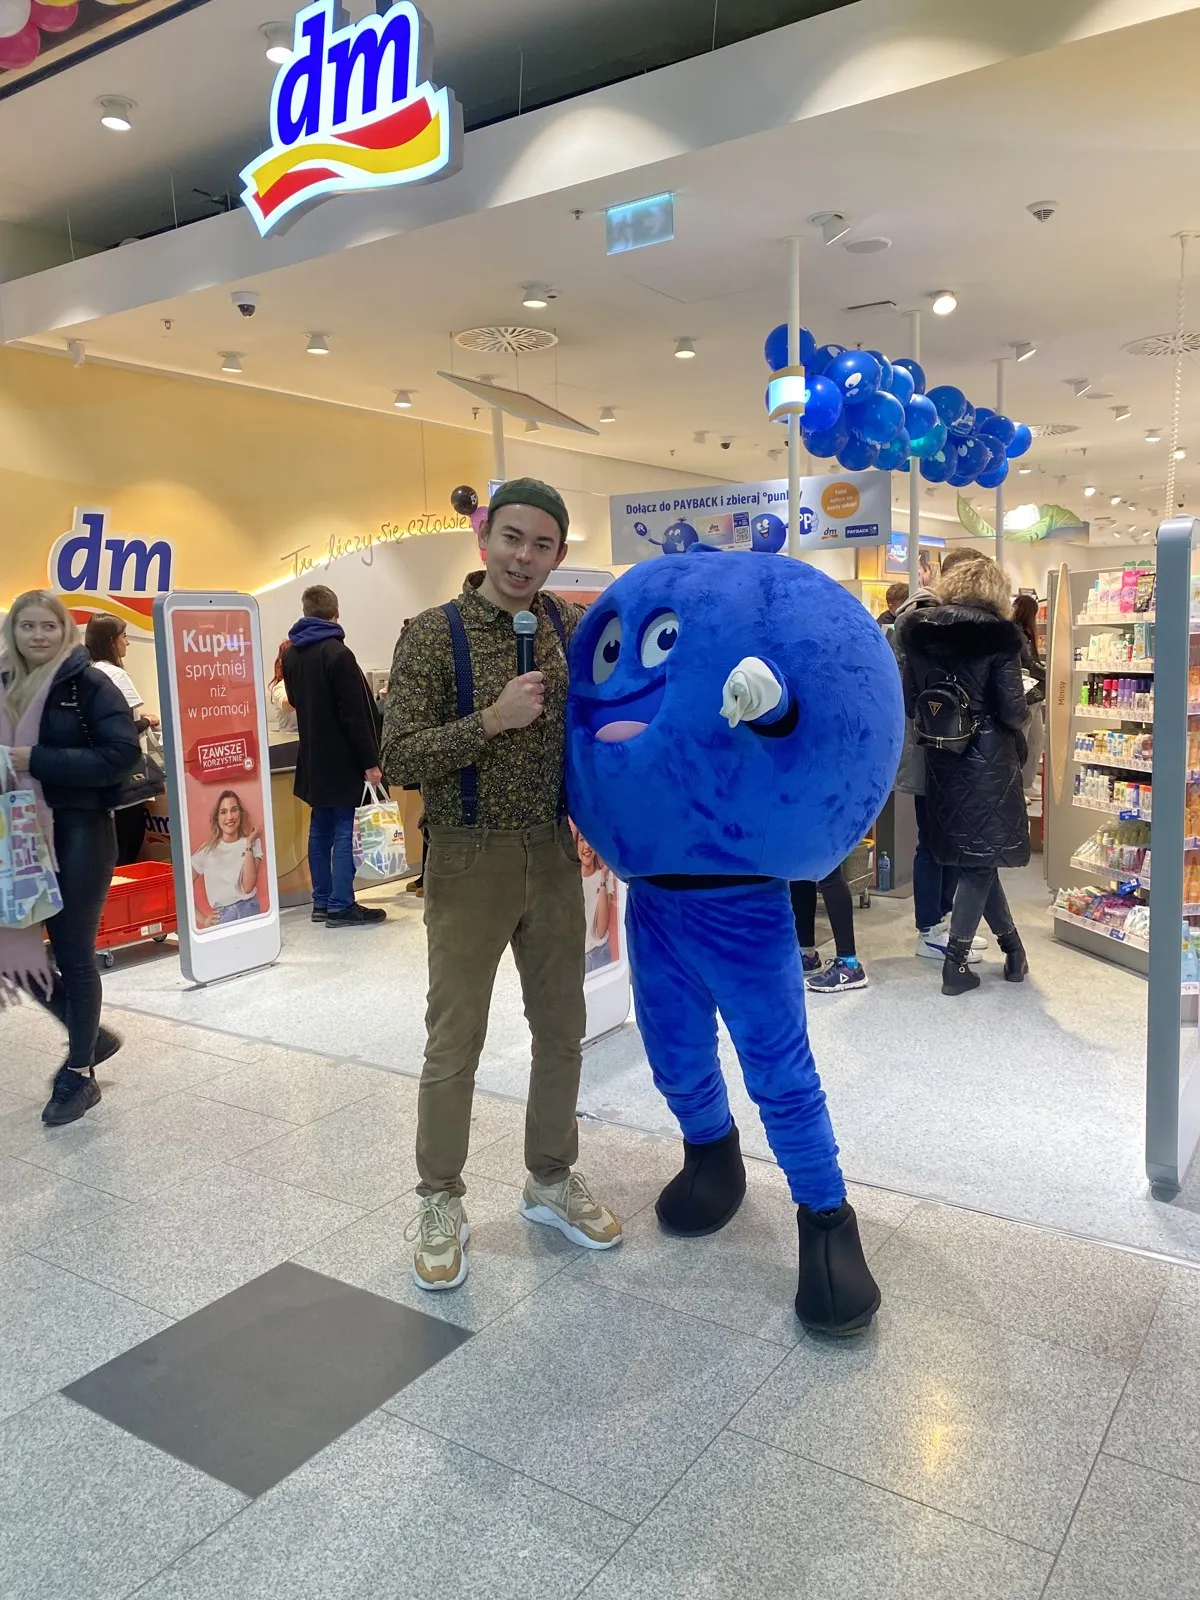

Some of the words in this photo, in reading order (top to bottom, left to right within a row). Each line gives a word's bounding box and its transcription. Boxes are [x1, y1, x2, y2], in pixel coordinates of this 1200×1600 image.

[277, 10, 411, 146] dm
[626, 503, 657, 516] Dołącz
[659, 501, 671, 511] do
[673, 497, 718, 510] PAYBACK
[720, 495, 724, 506] i
[726, 491, 761, 505] zbieraj
[324, 533, 374, 571] liczy
[407, 513, 472, 536] człowie
[823, 527, 837, 536] dm
[57, 512, 172, 592] dm
[182, 627, 245, 657] Kupuj
[185, 659, 247, 681] sprytniej
[210, 684, 227, 698] niż
[188, 707, 197, 719] w
[201, 700, 250, 720] promocji
[201, 742, 243, 760] ZAWSZE
[202, 754, 244, 768] KORZYSTNIE
